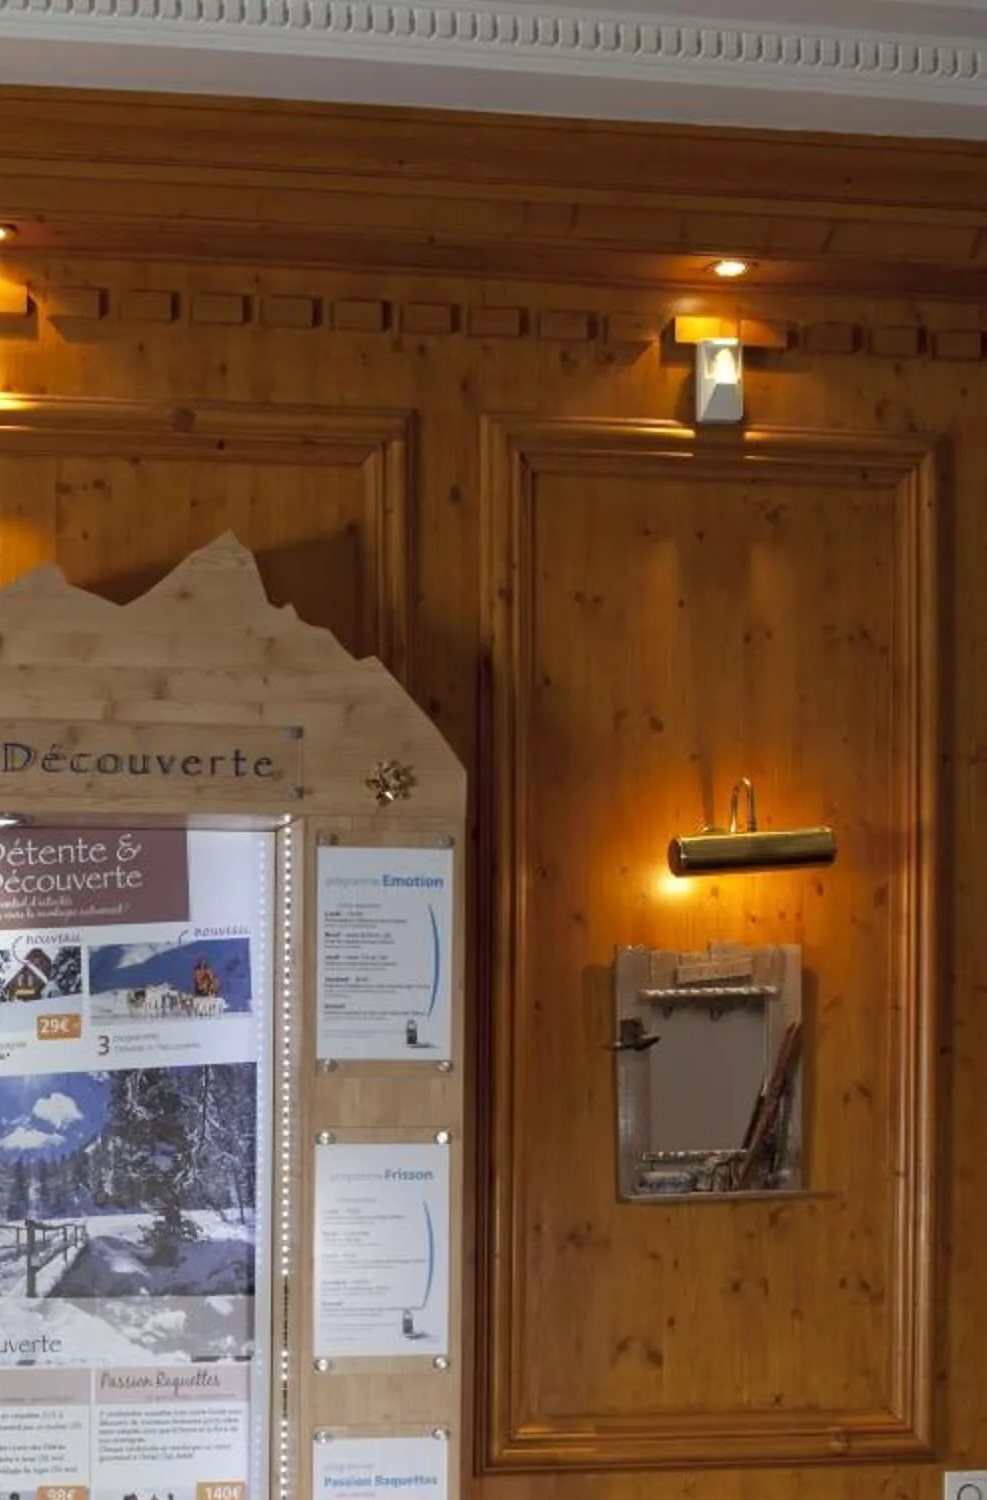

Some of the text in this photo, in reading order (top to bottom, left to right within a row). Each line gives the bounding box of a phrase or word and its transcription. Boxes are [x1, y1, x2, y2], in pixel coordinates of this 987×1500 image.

[1, 742, 274, 778] Découverte
[116, 833, 142, 862] &
[382, 874, 444, 888] Emotion
[97, 1035, 110, 1057] 3
[384, 1168, 433, 1181] Frisson
